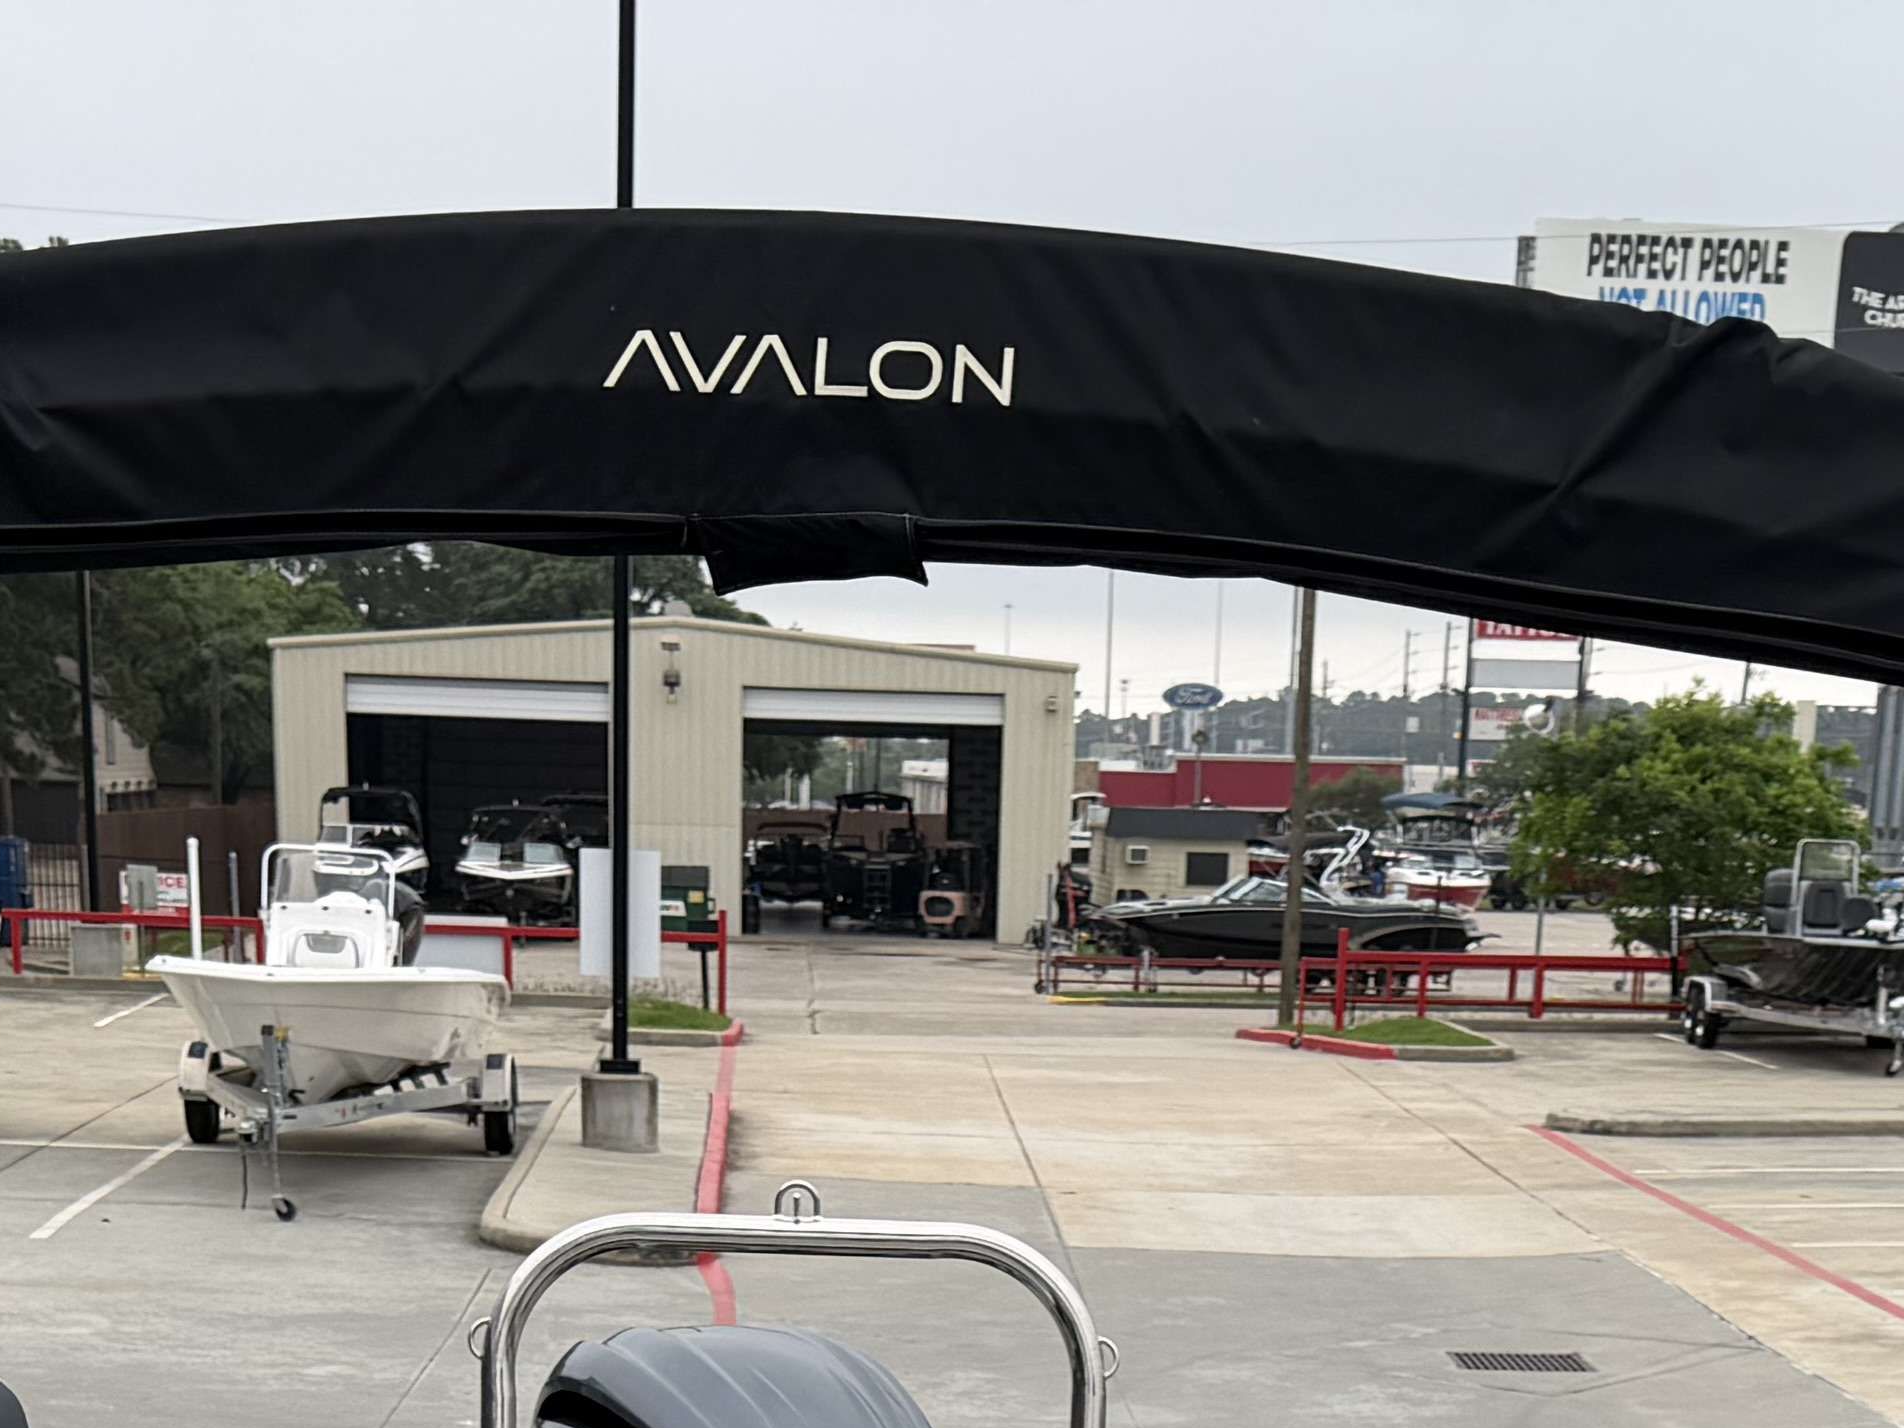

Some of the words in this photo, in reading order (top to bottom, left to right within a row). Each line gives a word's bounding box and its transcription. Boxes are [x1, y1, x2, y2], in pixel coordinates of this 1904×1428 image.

[1587, 233, 1694, 280] PERFECT
[1698, 238, 1789, 285] PEOPLE
[1852, 286, 1886, 308] THE
[602, 329, 1015, 406] AVALON
